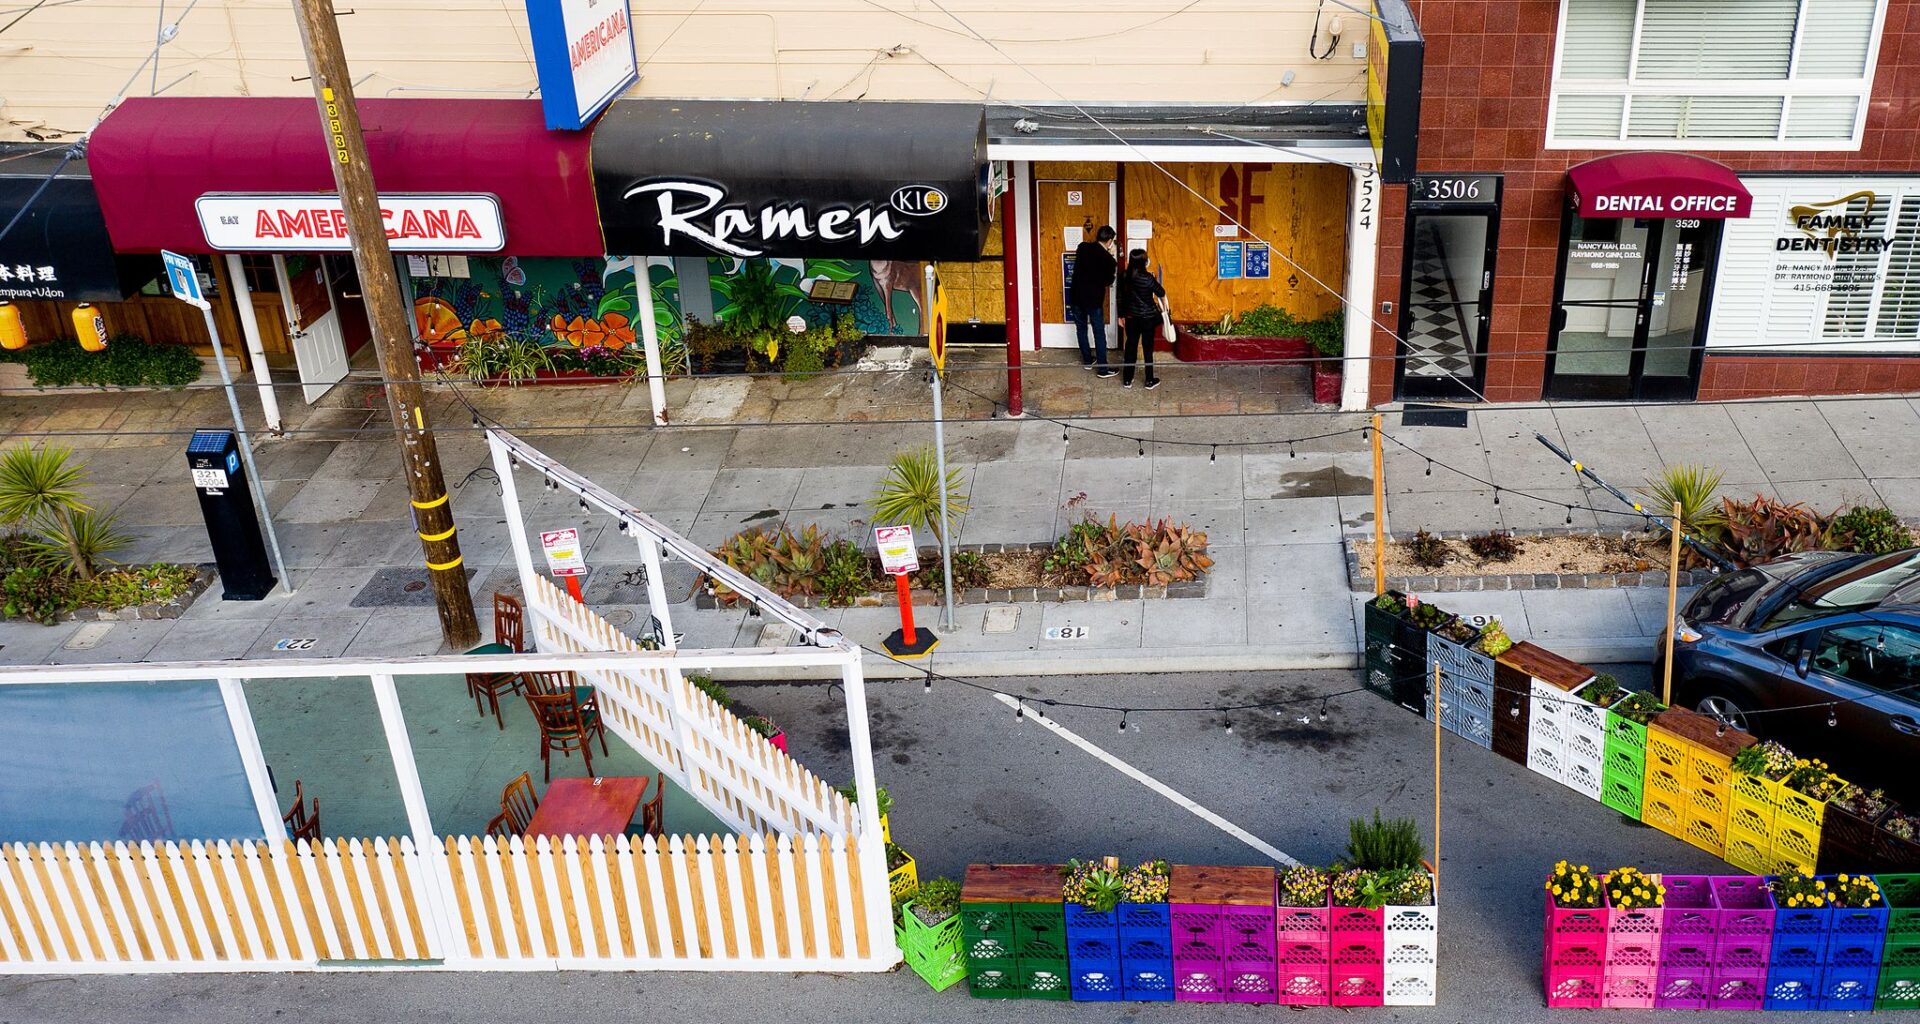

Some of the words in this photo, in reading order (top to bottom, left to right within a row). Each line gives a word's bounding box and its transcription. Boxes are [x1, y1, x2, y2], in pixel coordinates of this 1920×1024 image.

[571, 9, 626, 71] AMERICANA
[328, 105, 347, 162] 3532
[1428, 180, 1480, 199] 3506
[1595, 195, 1664, 211] DENTAL
[1670, 195, 1737, 211] OFFICE
[220, 216, 239, 225] EAT
[255, 209, 481, 239] AMERCANA
[624, 182, 904, 257] Ramen
[1675, 219, 1700, 228] 3520
[1797, 215, 1877, 229] FAMILY
[1776, 237, 1895, 251] DENTISTRY
[286, 638, 317, 649] 22
